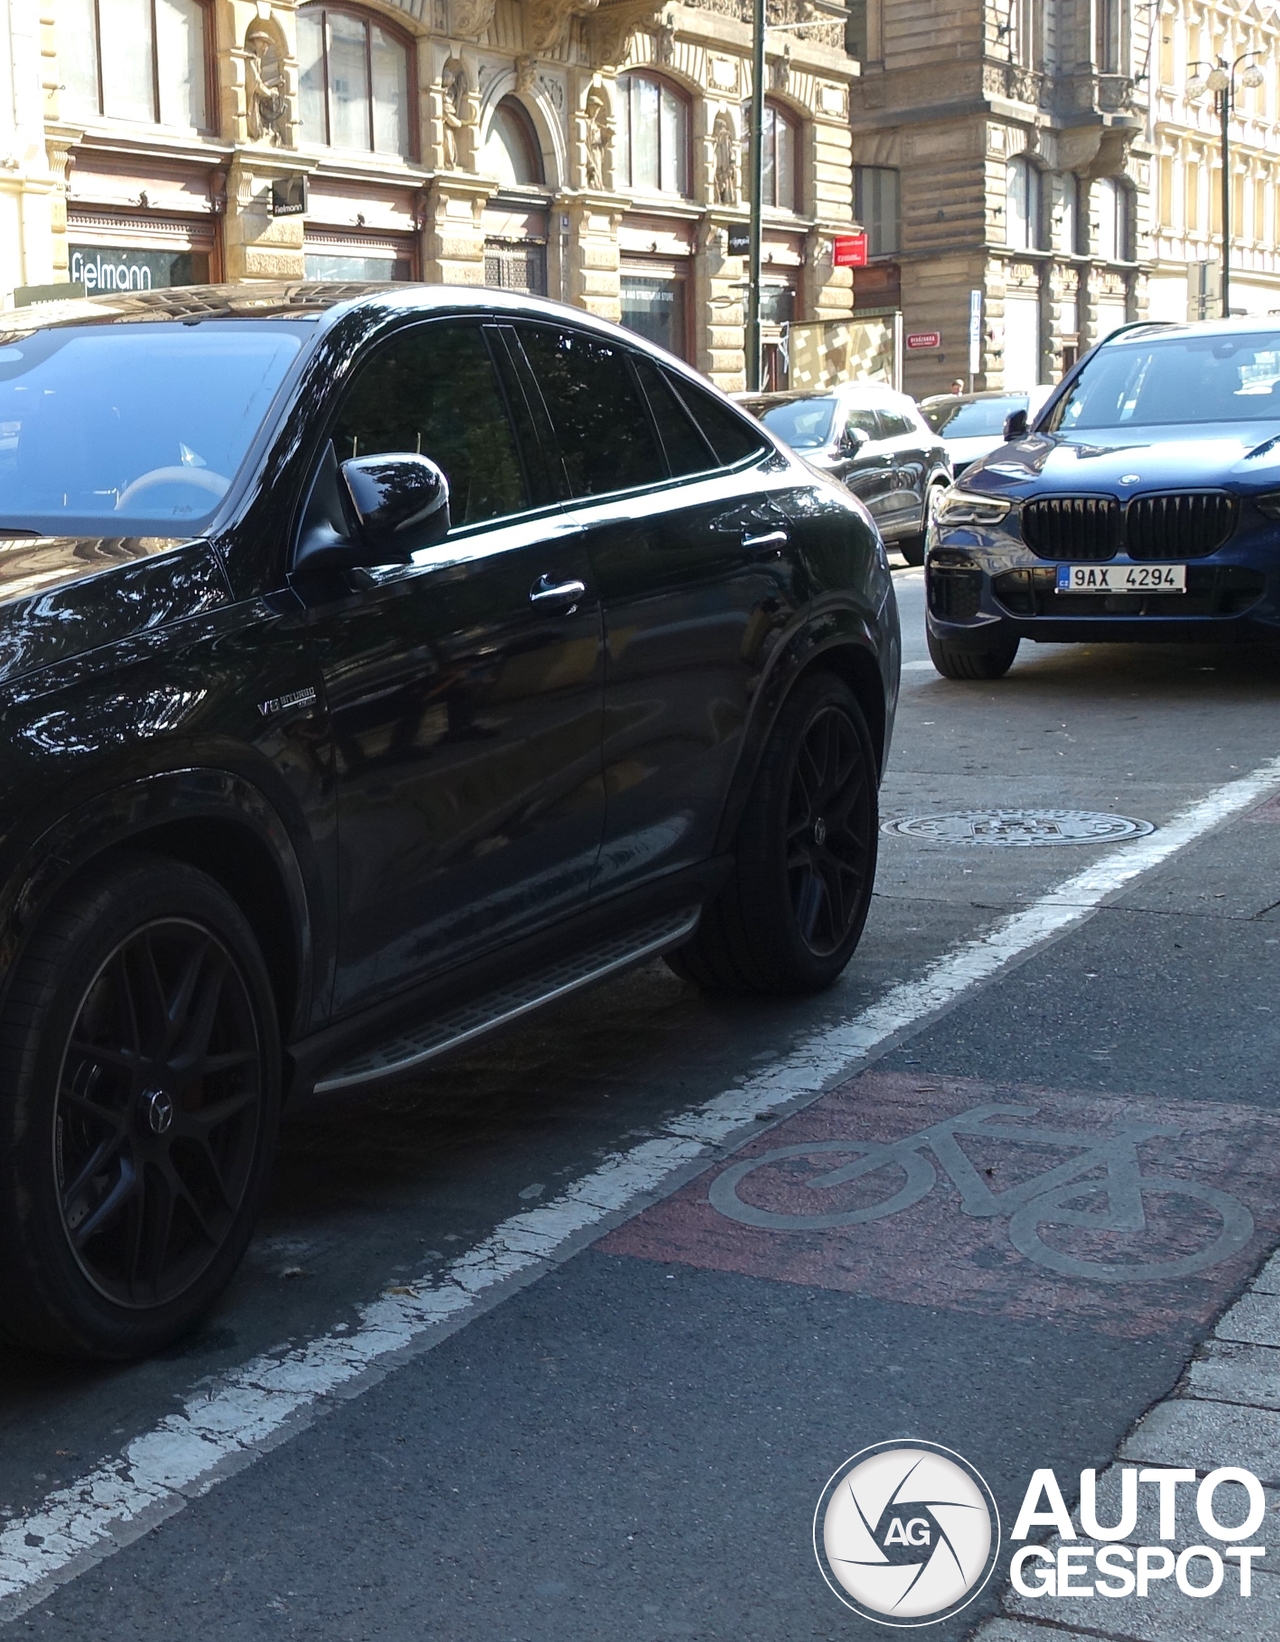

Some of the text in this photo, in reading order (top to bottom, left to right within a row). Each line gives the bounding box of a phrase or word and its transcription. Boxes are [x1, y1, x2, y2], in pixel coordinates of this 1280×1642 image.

[72, 252, 152, 291] fielmann
[1074, 568, 1175, 587] 9AX 4294
